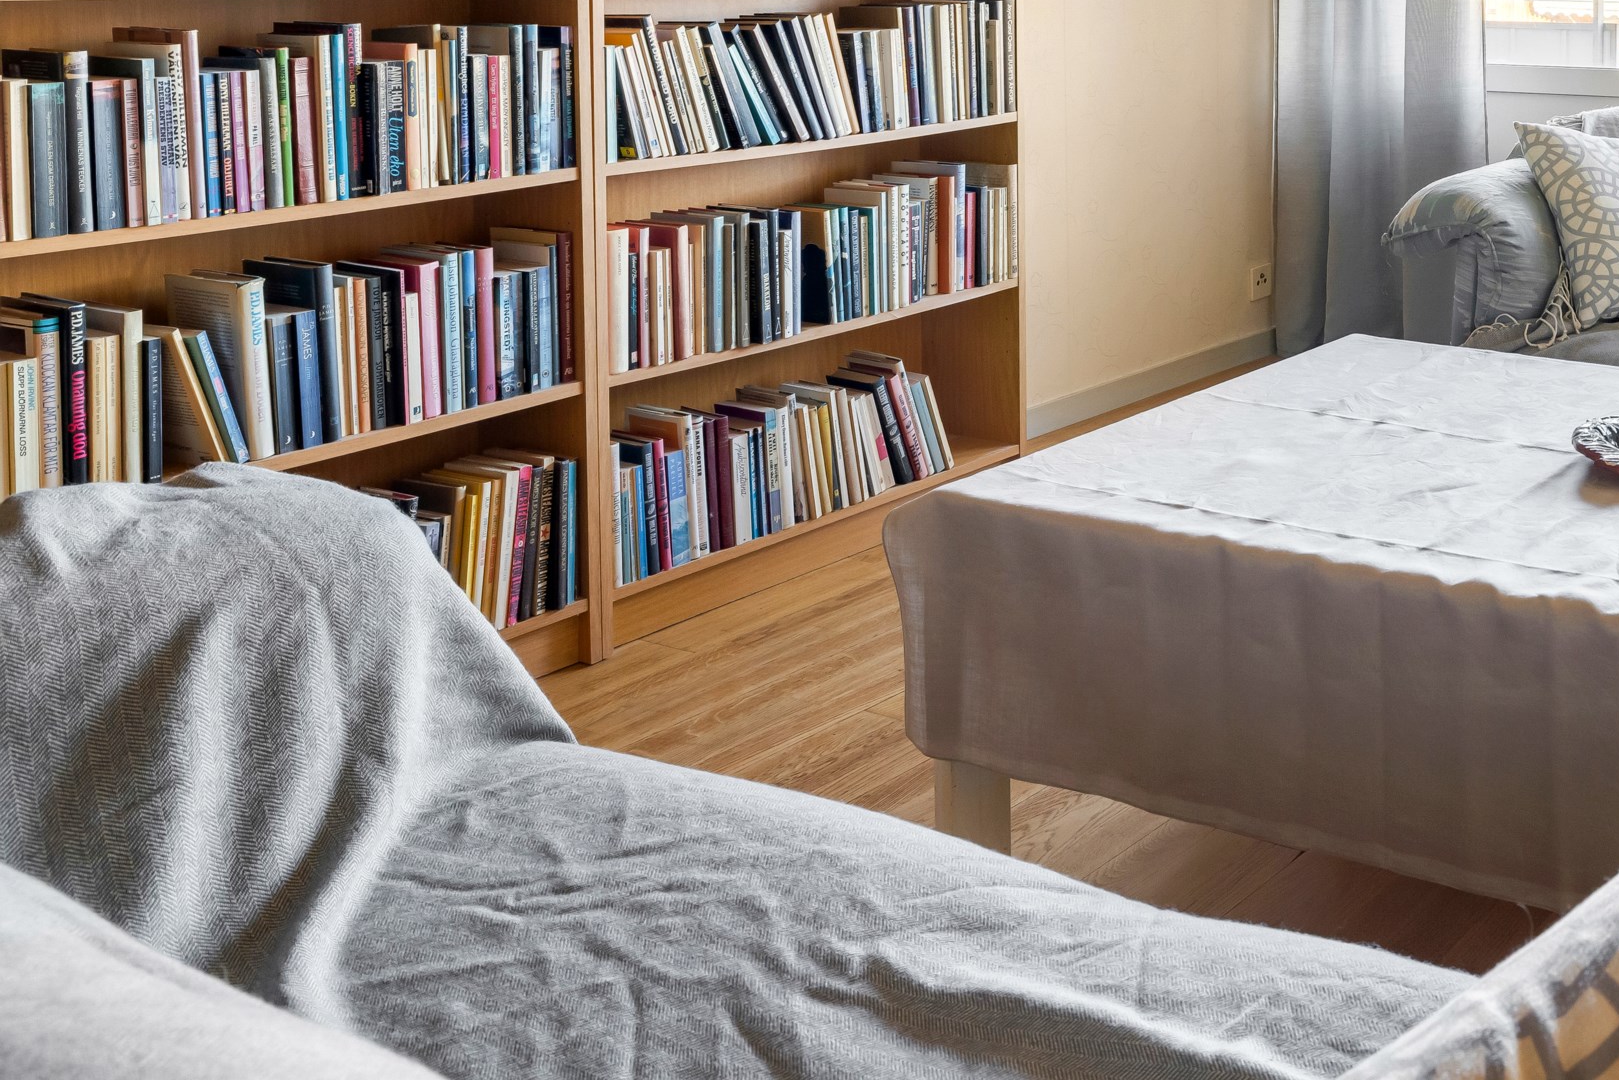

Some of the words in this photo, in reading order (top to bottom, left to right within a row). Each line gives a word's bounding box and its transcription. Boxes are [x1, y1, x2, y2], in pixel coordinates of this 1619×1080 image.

[220, 77, 228, 100] TONY
[390, 66, 403, 90] ANNE
[75, 87, 83, 109] Reginald
[164, 81, 172, 106] TONY
[391, 91, 403, 112] HOLT
[76, 110, 85, 120] Hill
[157, 81, 166, 142] PRESIDENTENS
[221, 101, 232, 151] HILLERMAN
[388, 117, 404, 152] Utan
[77, 132, 85, 166] MINNENAS
[160, 145, 168, 167] STAV
[224, 157, 233, 197] ODJURET
[390, 155, 404, 177] eko
[78, 167, 86, 193] TECKEN
[447, 260, 457, 282] Elsie
[372, 286, 380, 305] TOVE
[447, 282, 458, 333] Johansson
[250, 311, 262, 346] JAMES
[372, 308, 382, 341] JANSSON
[71, 329, 83, 365] JAMES
[302, 328, 312, 360] JAMES
[17, 366, 26, 388] SLÄPP
[27, 364, 35, 385] JOHN
[41, 353, 55, 393] KLOCKAN
[28, 386, 36, 411] IRVING
[67, 370, 86, 432] Onaturlig
[375, 361, 385, 420] SOMMARBOKEN
[18, 390, 28, 436] BJÖRNARNA
[41, 394, 59, 435] KLÄMTAR
[19, 437, 27, 457] LOSS
[43, 437, 60, 453] FÖR
[73, 432, 87, 460] död
[44, 455, 58, 475] MIG
[531, 476, 540, 501] JAMES
[530, 500, 538, 528] LEASOR
